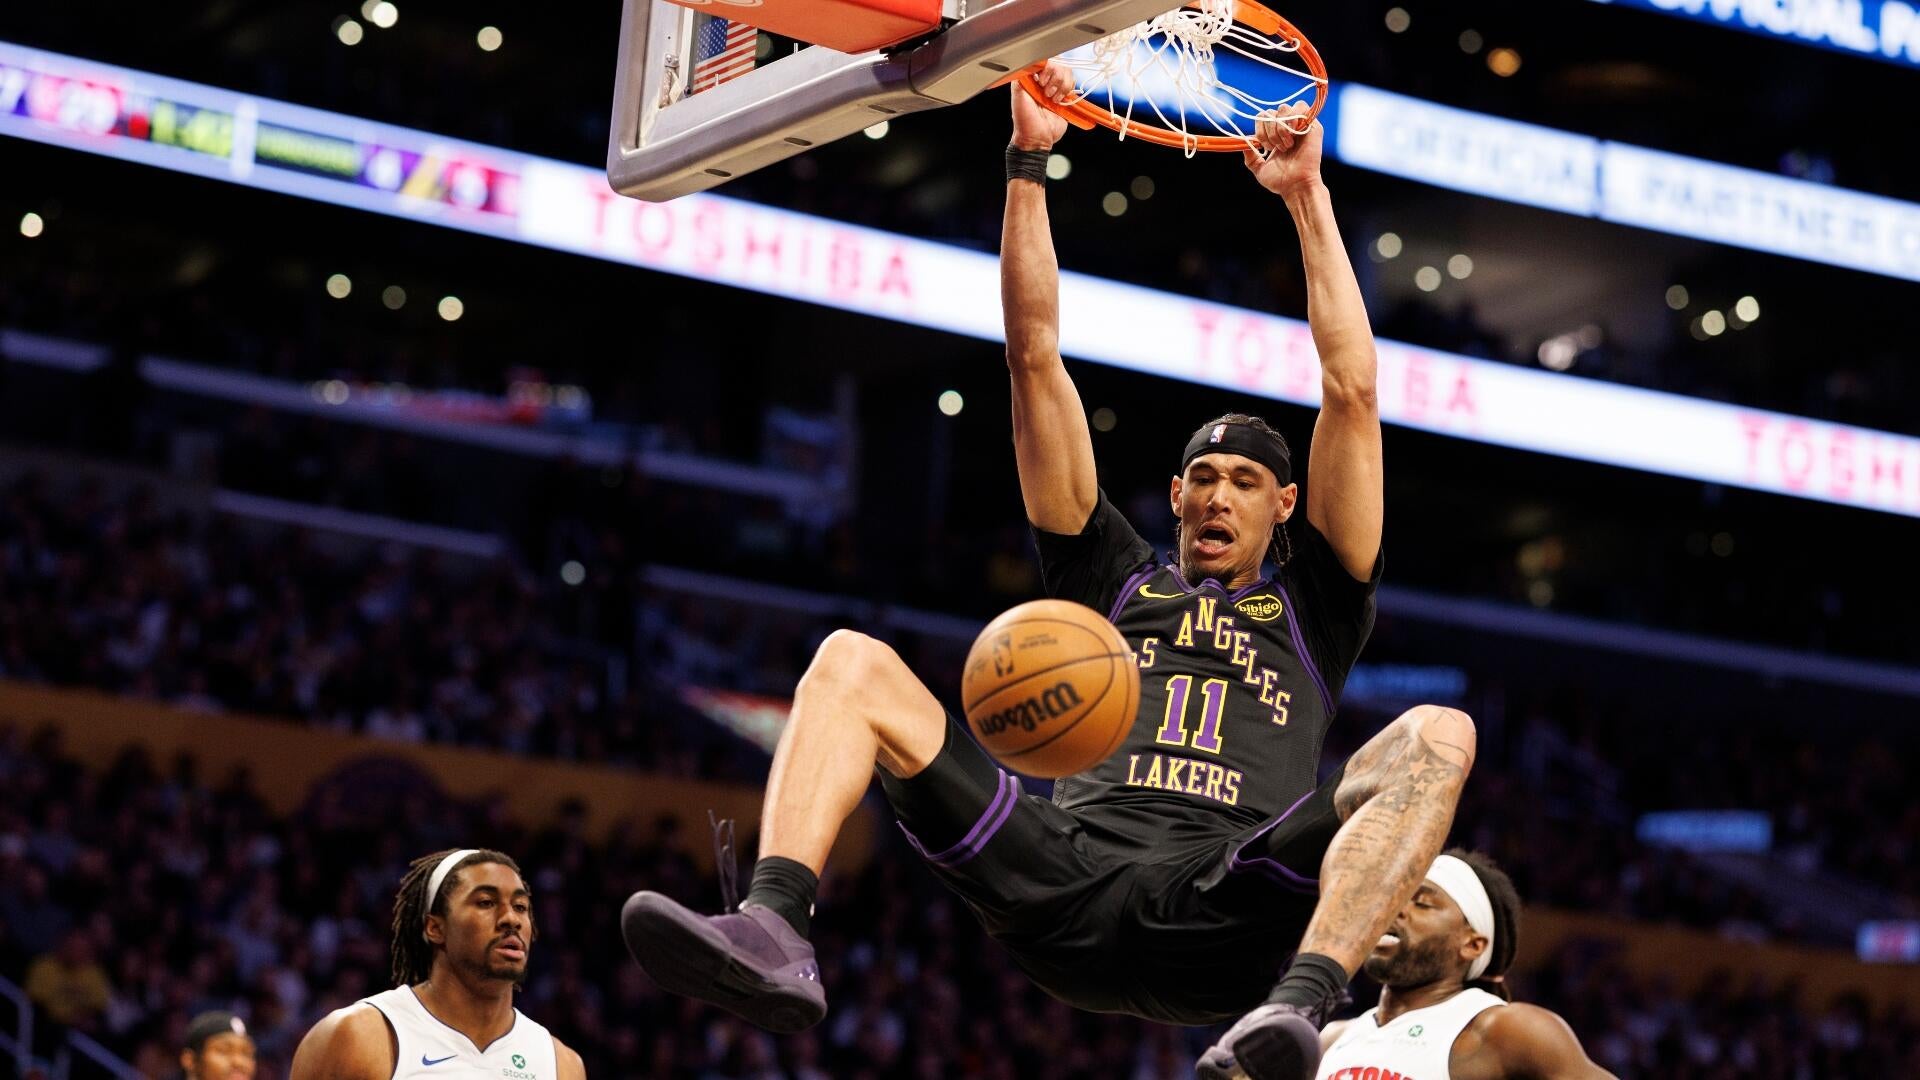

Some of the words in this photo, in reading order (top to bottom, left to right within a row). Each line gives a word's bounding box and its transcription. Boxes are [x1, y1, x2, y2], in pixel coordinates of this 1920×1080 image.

[585, 174, 914, 306] TOSHIBA
[1238, 602, 1280, 615] bibigo
[1173, 597, 1291, 726] ANGELES
[975, 682, 1084, 738] Wilson
[1155, 674, 1229, 755] 11
[1125, 754, 1243, 806] LAKERS
